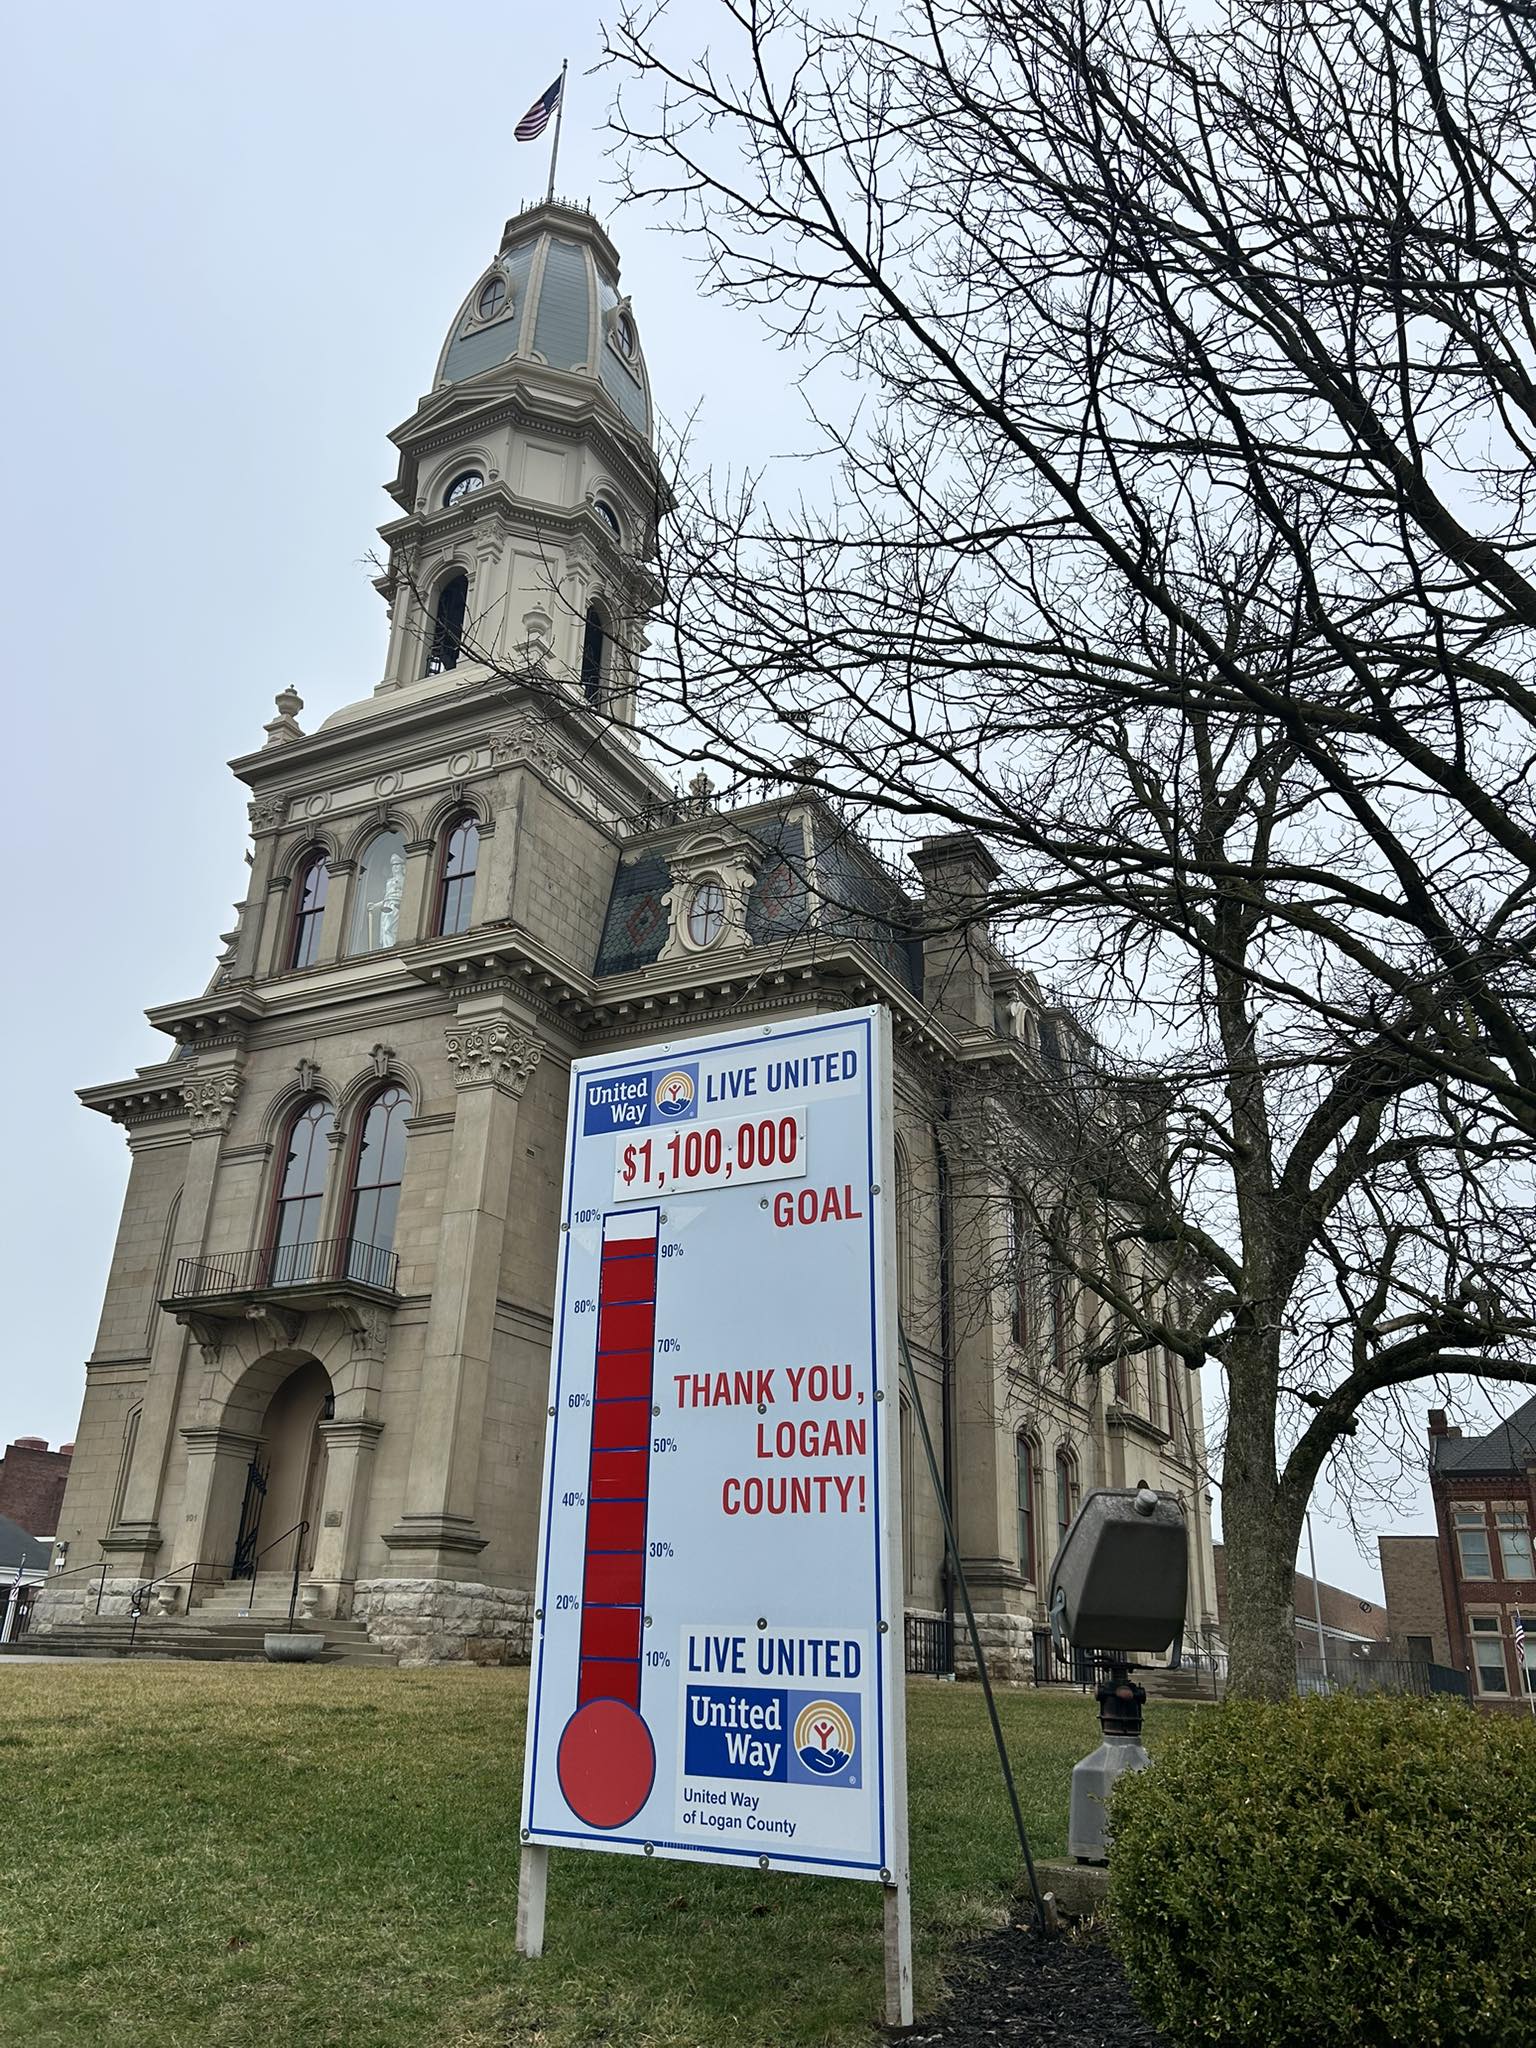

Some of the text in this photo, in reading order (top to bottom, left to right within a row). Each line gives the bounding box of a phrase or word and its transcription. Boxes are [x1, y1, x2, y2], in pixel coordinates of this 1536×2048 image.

[706, 1050, 857, 1103] LIVE UNITED
[588, 1077, 648, 1107] United
[611, 1103, 648, 1126] Way
[622, 1116, 797, 1189] $1,100,000
[574, 1208, 600, 1223] 100%
[773, 1184, 863, 1228] GOAL
[661, 1243, 684, 1258] 90%
[574, 1300, 596, 1314] 80%
[657, 1338, 681, 1353] 70%
[674, 1364, 865, 1408] THANK YOU,
[568, 1393, 591, 1408] 60%
[653, 1438, 677, 1453] 50%
[757, 1418, 867, 1458] LOGAN
[562, 1492, 585, 1507] 40%
[722, 1475, 866, 1515] COUNTY!
[649, 1542, 674, 1558] 30%
[556, 1595, 579, 1610] 20%
[646, 1651, 671, 1667] 10%
[688, 1636, 861, 1678] LIVE UNITED
[691, 1696, 781, 1731] United
[725, 1733, 781, 1776] Way
[682, 1788, 760, 1809] United Way
[682, 1810, 797, 1838] of Logan County
